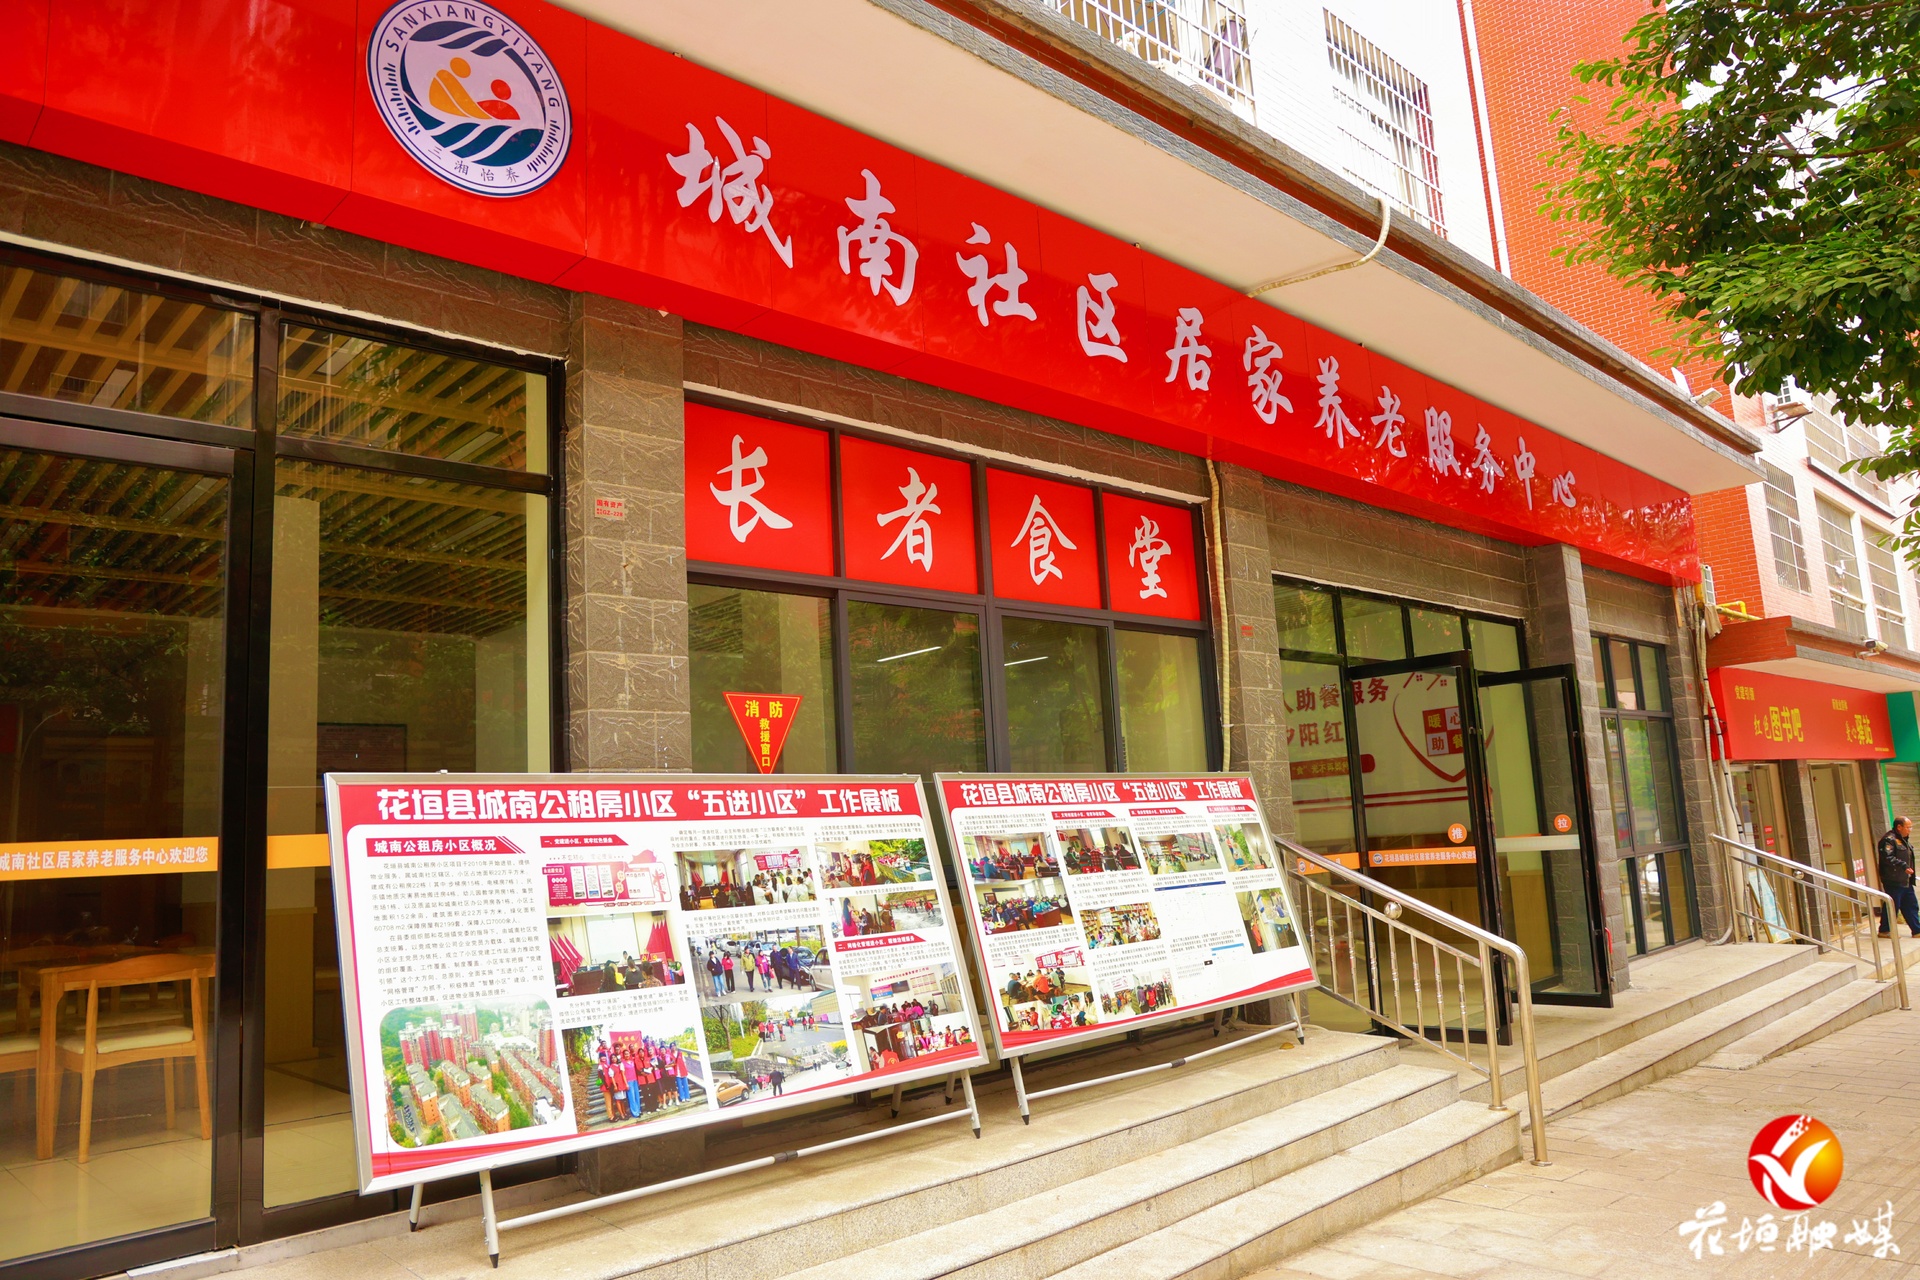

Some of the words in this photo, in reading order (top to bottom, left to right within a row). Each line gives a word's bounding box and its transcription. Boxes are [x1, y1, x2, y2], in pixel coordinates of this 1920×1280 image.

[386, 4, 560, 108] SANXIANGYIYANG
[427, 145, 520, 183] 三湘怡养
[666, 115, 1577, 510] 城南社区居家养老服务中心
[709, 433, 1172, 600] 长者食堂
[744, 699, 784, 718] 消防
[1753, 705, 1804, 743] 红色图书吧
[759, 718, 771, 767] 救援窗口
[377, 787, 902, 821] 花垣县城南公租房小区“五进小区”工作展板
[960, 780, 1244, 806] 花垣县城南公租房小区“五进小区”工作展板
[1451, 827, 1464, 840] 推
[1556, 817, 1569, 829] 拉
[373, 838, 497, 854] 城南公租房小区概况
